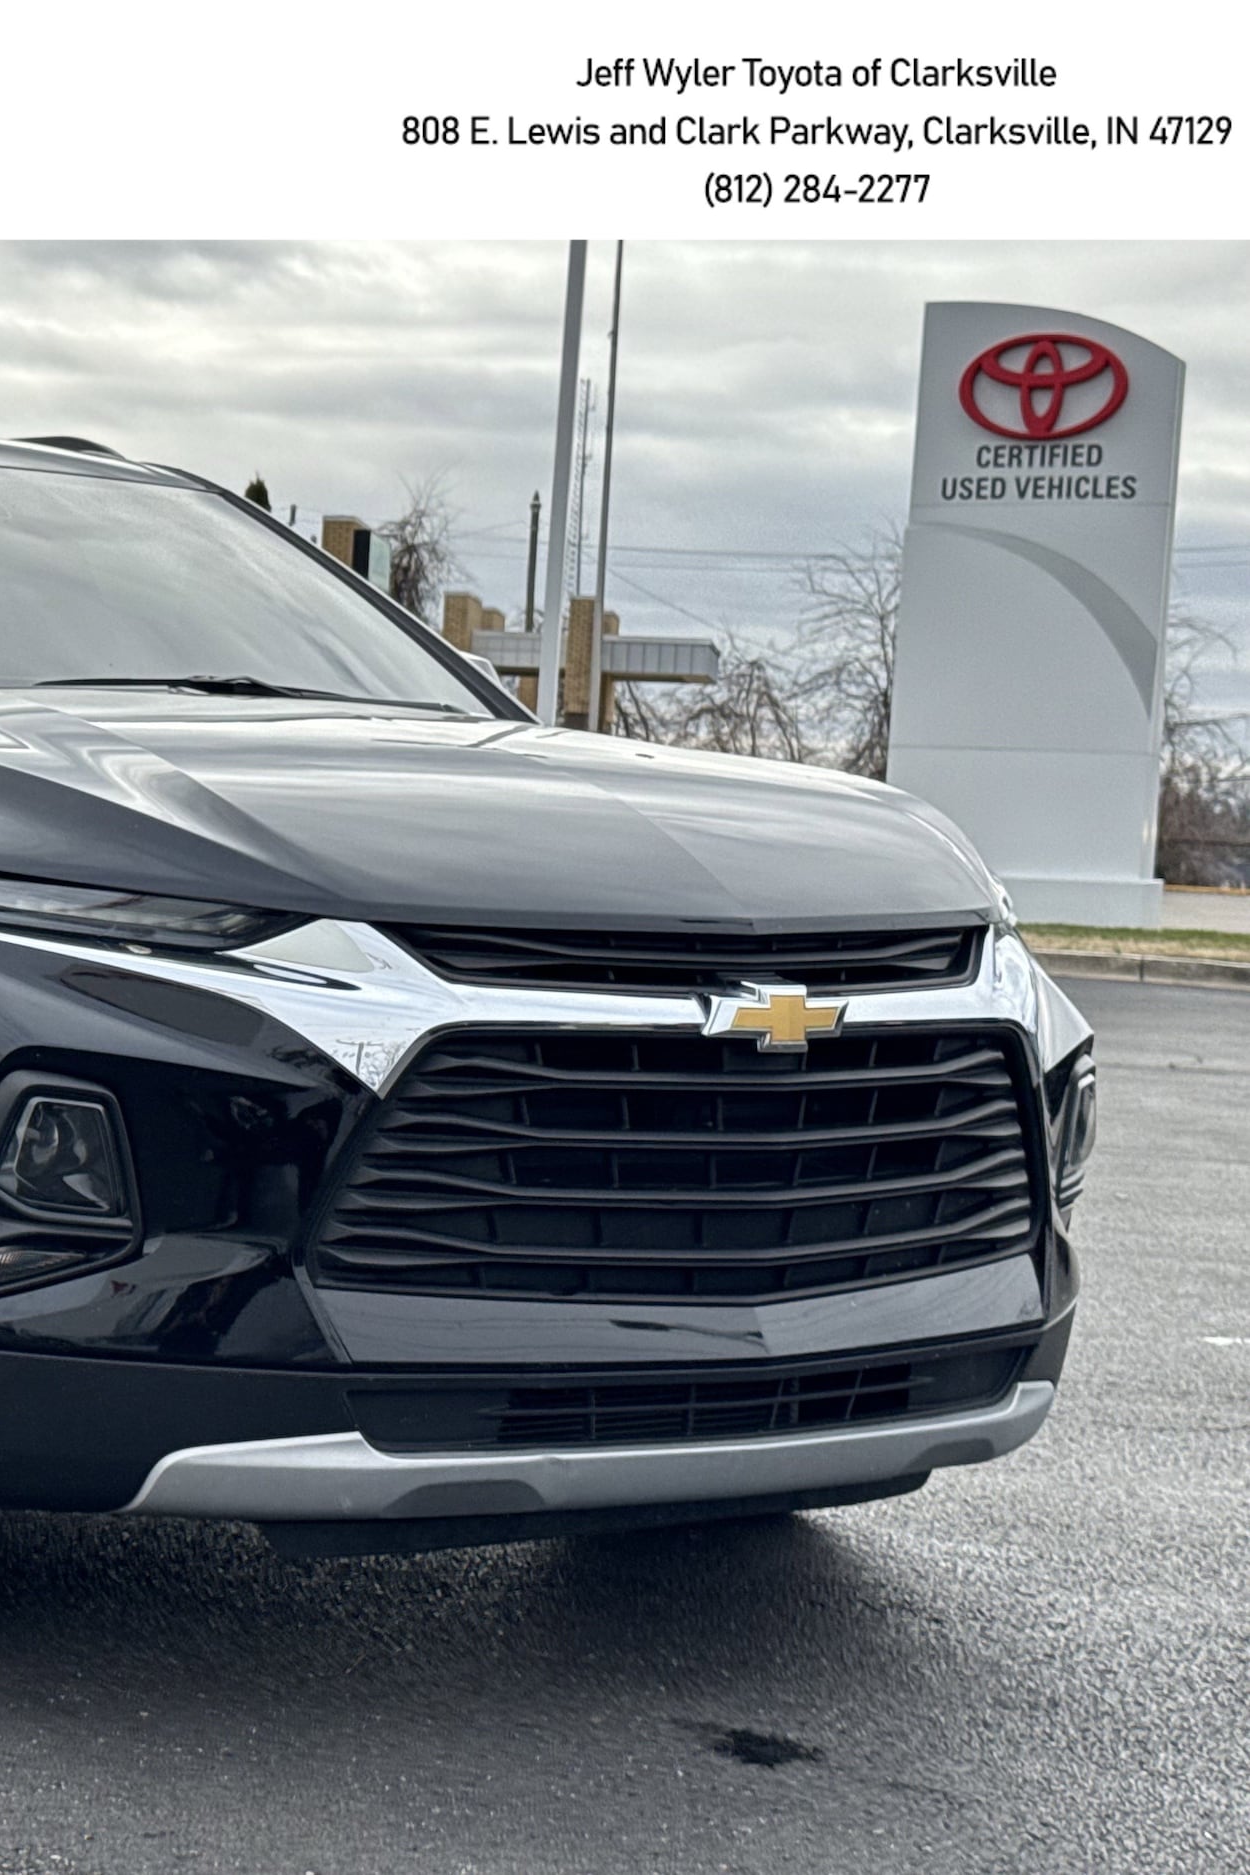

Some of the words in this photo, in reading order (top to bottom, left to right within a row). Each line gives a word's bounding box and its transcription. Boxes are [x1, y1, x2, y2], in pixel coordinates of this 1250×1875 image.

[975, 444, 1103, 469] CERTIFIED
[940, 476, 1007, 501] USED
[1015, 475, 1137, 500] VEHICLES
